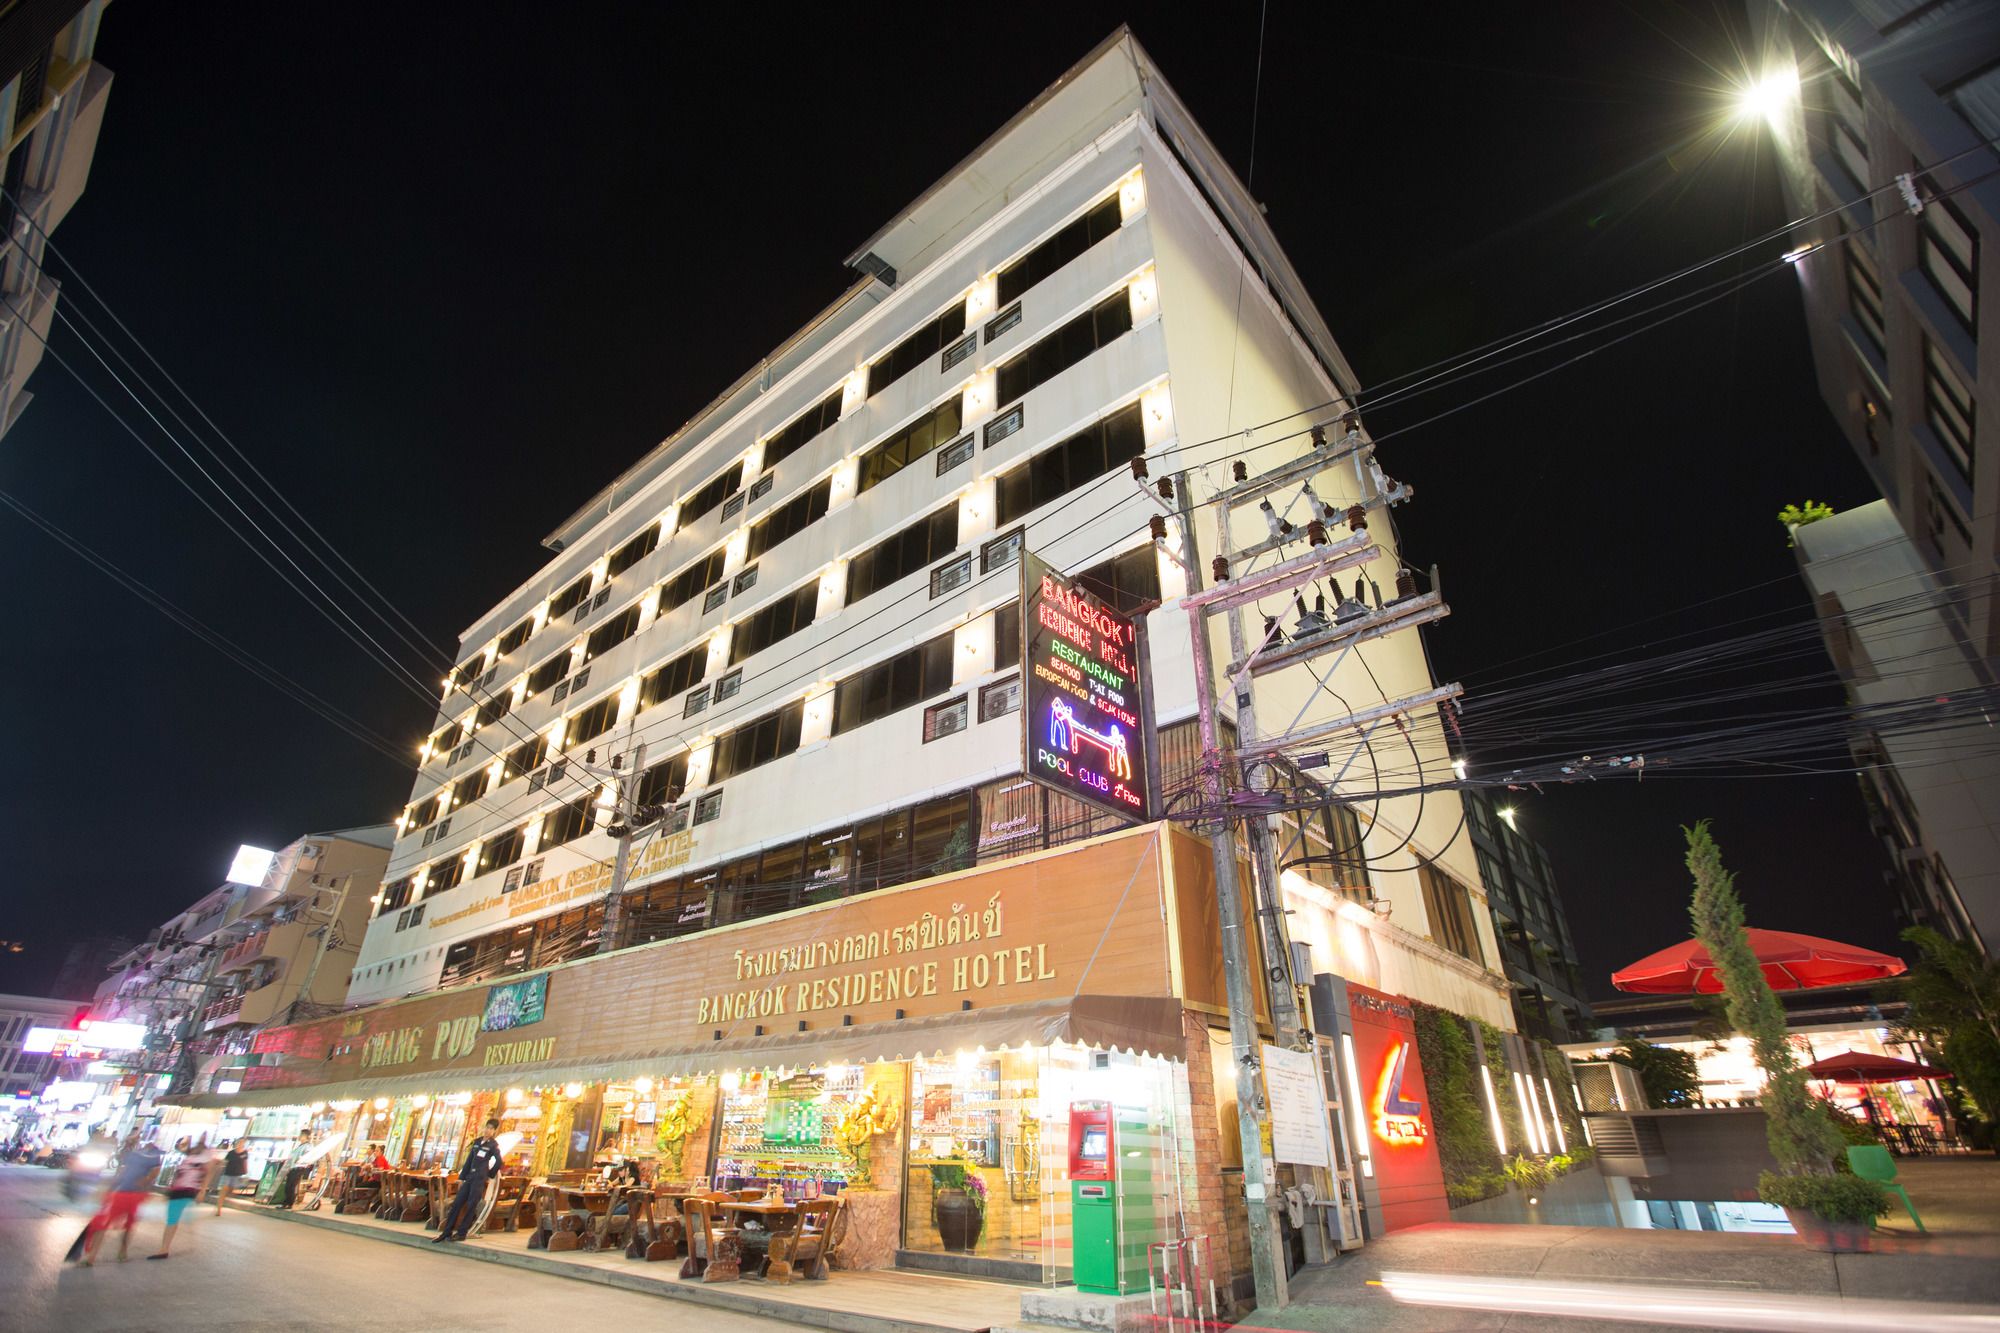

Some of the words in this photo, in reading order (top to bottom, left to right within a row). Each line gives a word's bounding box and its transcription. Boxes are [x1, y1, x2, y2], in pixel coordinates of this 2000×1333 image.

[1040, 602, 1092, 651] RESIDENCE
[1042, 576, 1123, 647] BANGKOK
[1035, 664, 1070, 691] EUROPEAN
[1089, 694, 1097, 706] &
[1051, 657, 1081, 682] SEAFOOD
[1107, 689, 1125, 706] FOOD
[1052, 639, 1124, 691] RESTAURANT
[1038, 748, 1074, 777] POOL
[1079, 768, 1109, 792] CLUB
[1123, 789, 1141, 807] Floor
[508, 873, 562, 908] BANGKOK
[643, 829, 699, 864] HOTEL
[697, 984, 788, 1025] BANGKOK
[796, 961, 939, 1013] RESIDENCE
[952, 943, 1057, 993] HOTEL
[360, 1025, 424, 1068] CHANG
[431, 1015, 481, 1060] PUB
[483, 1037, 556, 1067] RESTAURANT
